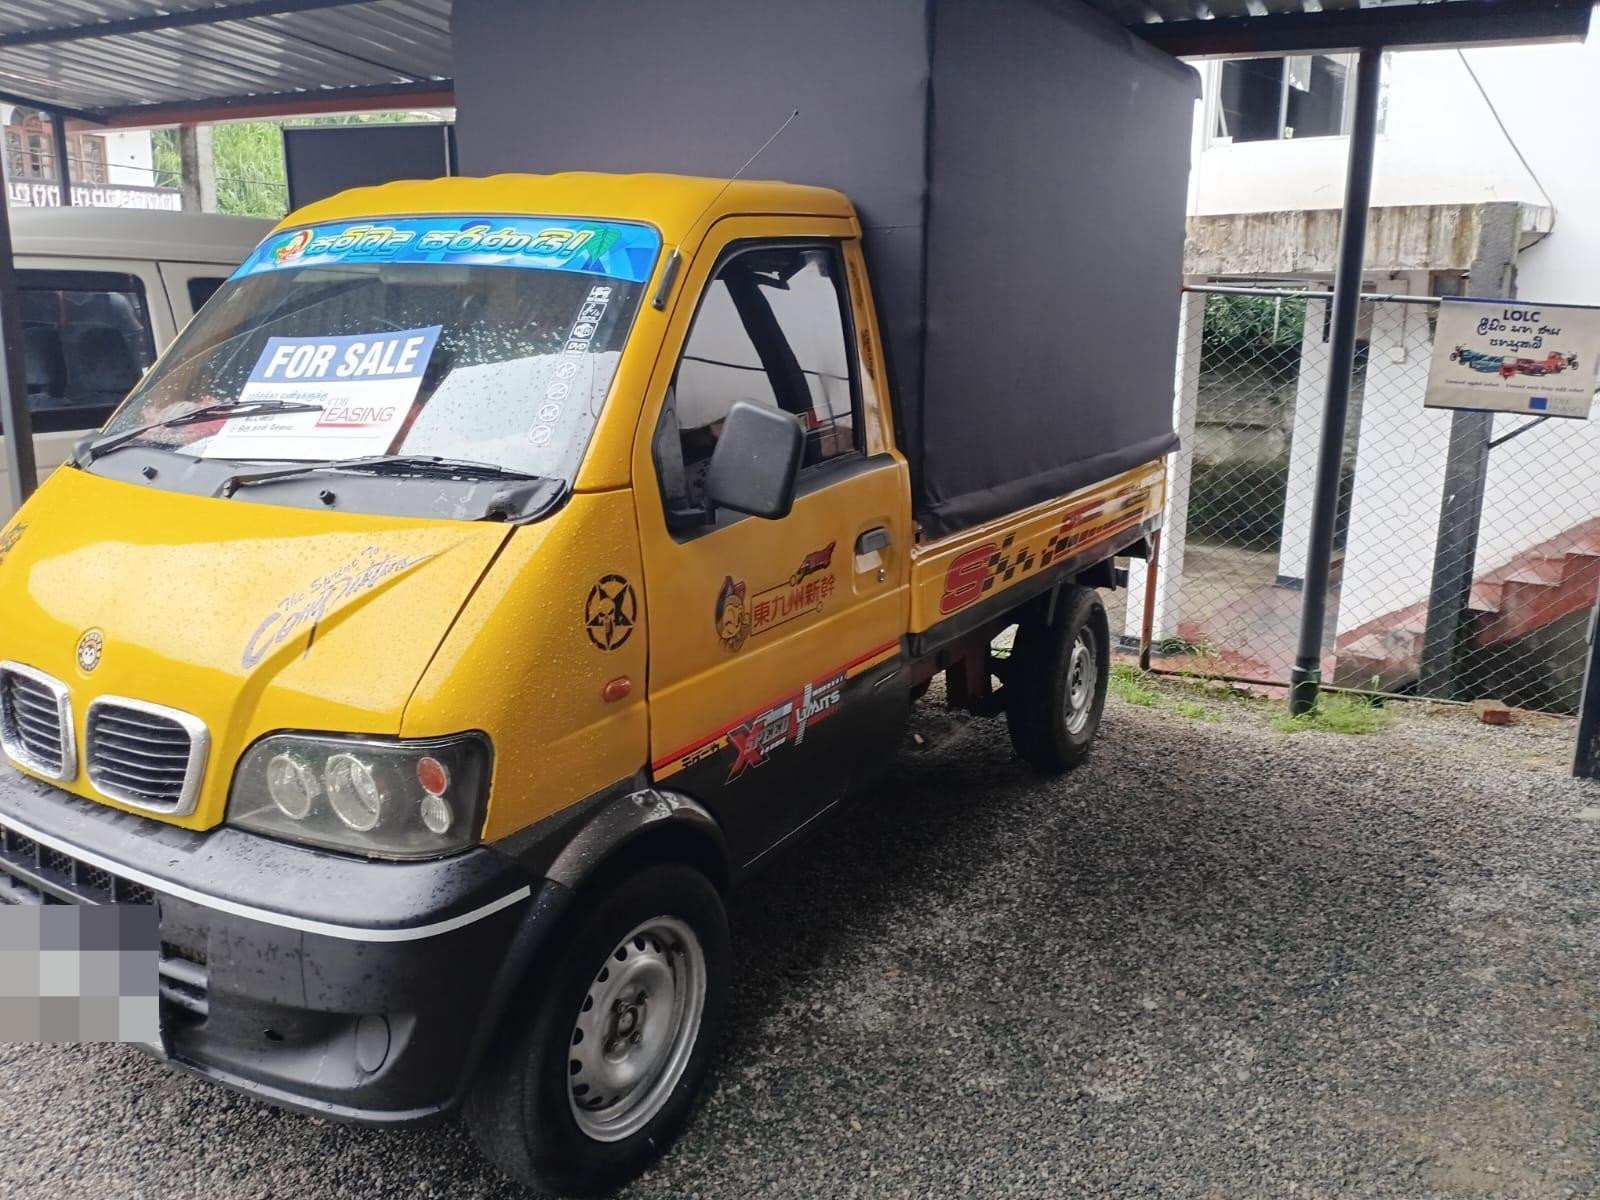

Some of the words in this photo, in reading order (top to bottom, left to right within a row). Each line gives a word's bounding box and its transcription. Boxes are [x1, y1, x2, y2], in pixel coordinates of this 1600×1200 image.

[1503, 309, 1541, 323] LOLC
[263, 345, 336, 379] FOR
[336, 336, 425, 377] SALE
